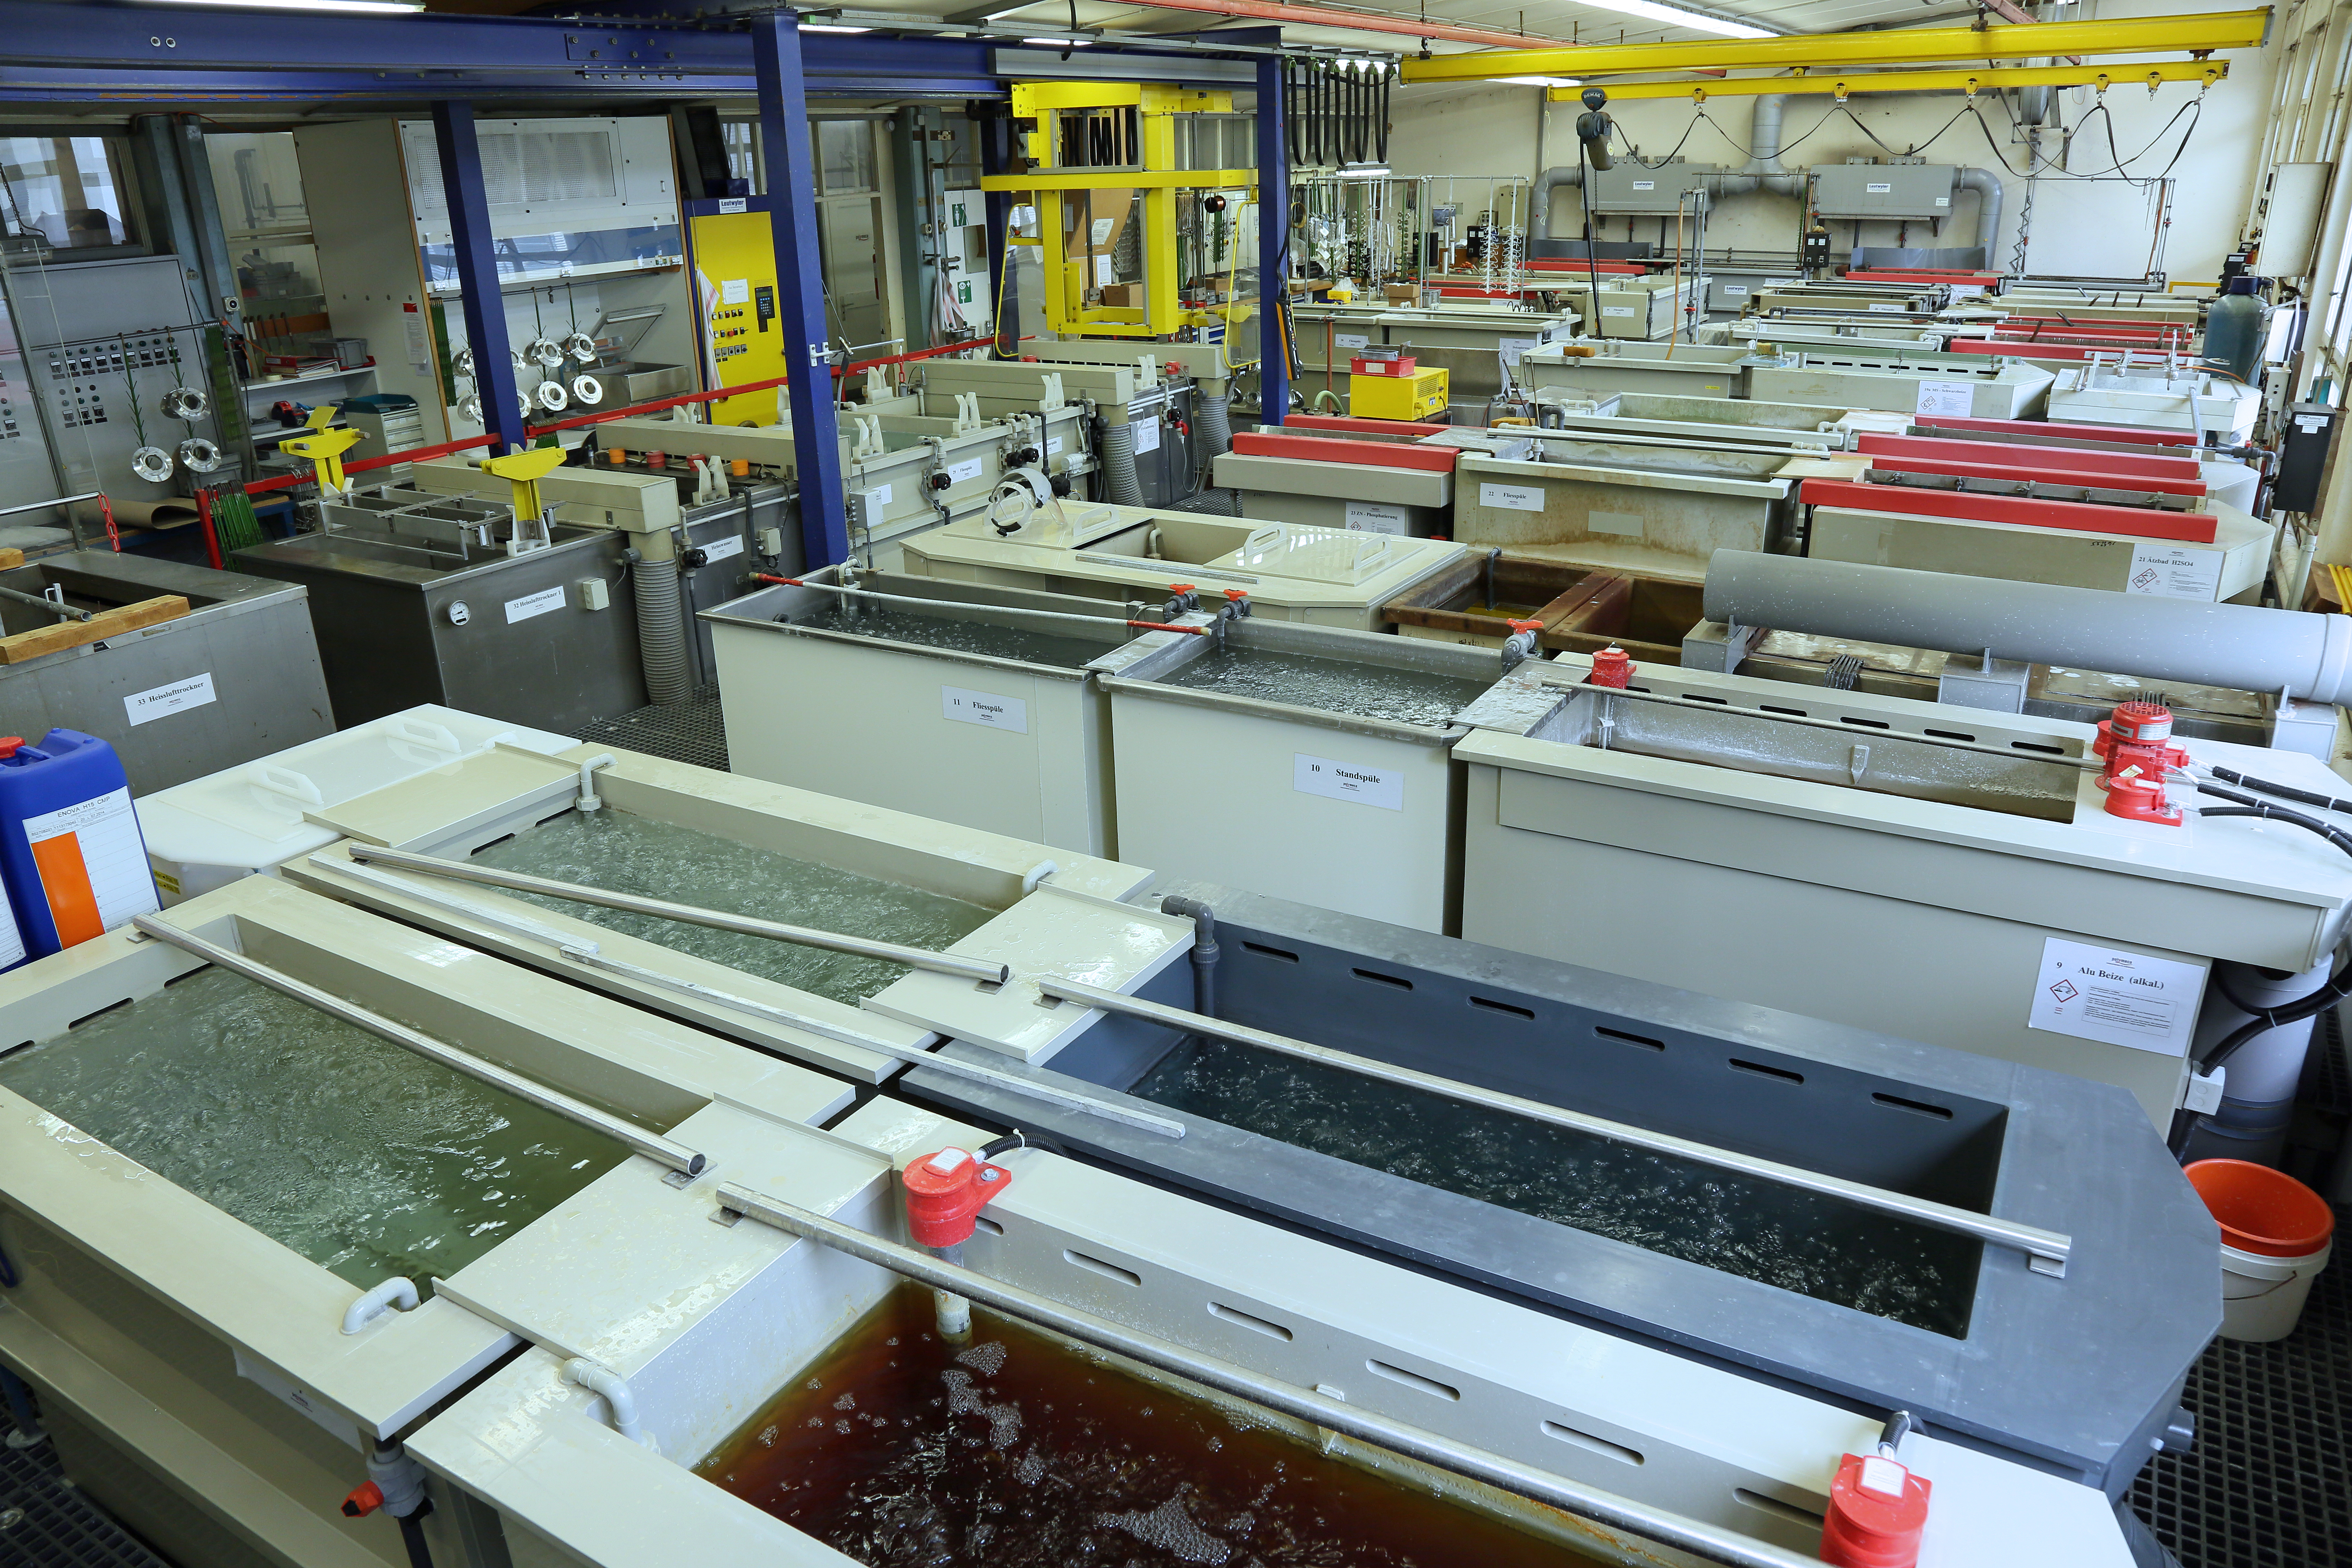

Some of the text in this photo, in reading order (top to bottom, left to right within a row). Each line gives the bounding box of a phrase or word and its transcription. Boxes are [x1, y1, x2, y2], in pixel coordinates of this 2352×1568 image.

[711, 541, 733, 550] Heisswasser
[520, 592, 557, 607] Heisslufttrockner
[149, 682, 204, 702] Heisslufttrockner
[973, 702, 1004, 713] Fliesspüle
[1311, 764, 1381, 783] 10 Standspüle
[58, 807, 80, 817] ENOVA
[83, 802, 94, 810] H15
[97, 796, 110, 805] CMP
[2111, 957, 2133, 965] polymeca
[2078, 967, 2096, 976] Alu
[2098, 970, 2124, 981] Beize
[2129, 976, 2164, 990] (alkal.)
